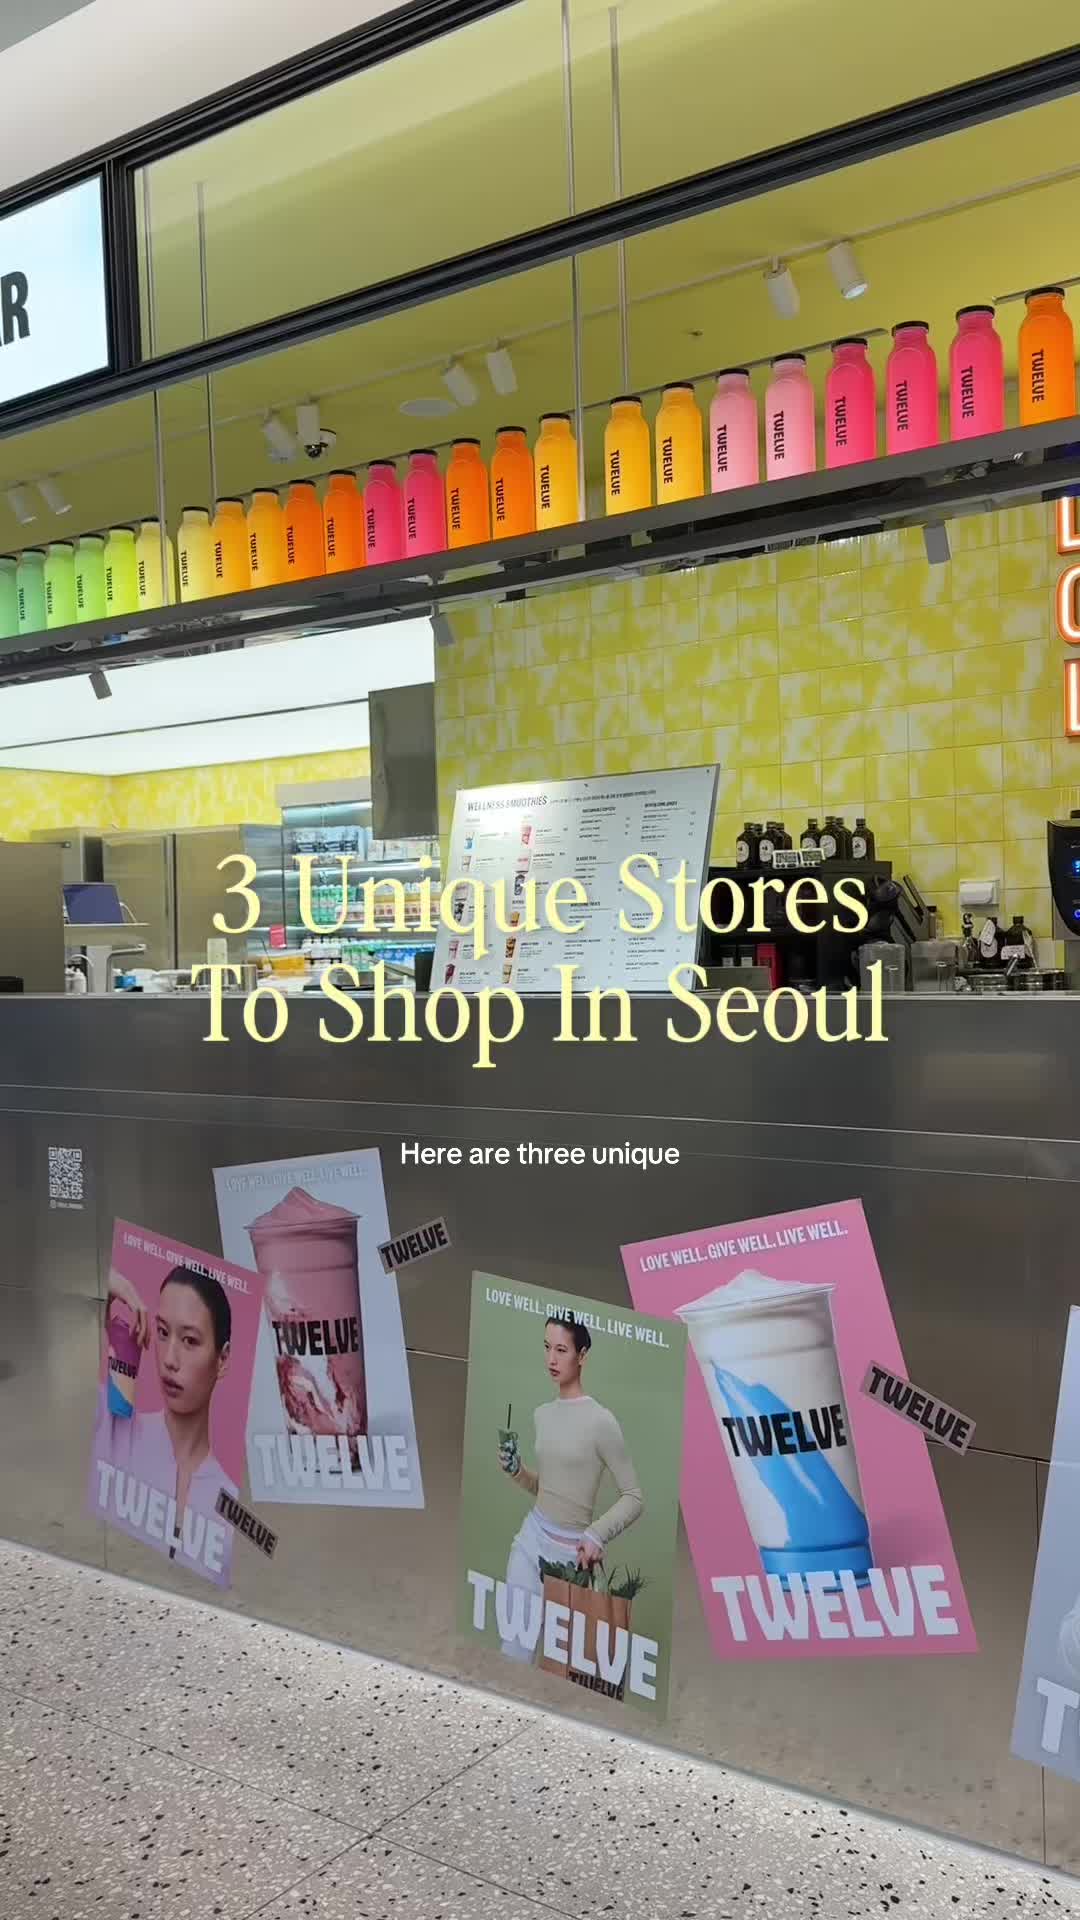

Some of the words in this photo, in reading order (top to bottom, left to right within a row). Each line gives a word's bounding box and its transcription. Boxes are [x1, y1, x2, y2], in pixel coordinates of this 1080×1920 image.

[0, 271, 30, 347] R
[961, 366, 974, 419] TWELVE
[1032, 349, 1044, 403] TWELVE
[835, 396, 847, 447] TWELVE
[896, 380, 908, 432] TWELVE
[662, 436, 673, 484] TWELVE
[717, 424, 728, 473] TWELVE
[773, 410, 785, 460] TWELVE
[540, 464, 551, 509] TWELVE
[610, 450, 621, 496] TWELVE
[406, 497, 417, 540] TWELVE
[450, 487, 461, 529] TWELVE
[496, 477, 505, 521] TWELVE
[250, 532, 258, 571] TWELVE
[286, 525, 295, 565] TWELVE
[327, 517, 336, 558] TWELVE
[366, 508, 376, 549] TWELVE
[180, 550, 188, 587] TWELVE
[214, 541, 223, 578] TWELVE
[124, 1231, 142, 1249] LOVE
[166, 1249, 184, 1267] GIVE
[208, 1266, 227, 1285] LIVE
[381, 1222, 448, 1269] TWELVE
[640, 1252, 670, 1272] LOVE
[671, 1246, 708, 1266] WELL.
[708, 1239, 737, 1260] GIVE
[737, 1233, 776, 1254] WELL.
[776, 1227, 806, 1247] LIVE
[808, 1220, 849, 1241] WELL.
[272, 1316, 360, 1356] TWELVE
[485, 1287, 513, 1307] LOVE
[513, 1294, 545, 1316] WELL.
[546, 1303, 571, 1323] GIVE
[572, 1309, 606, 1332] WELL.
[607, 1318, 633, 1339] LIVE
[634, 1326, 670, 1349] WELL.
[722, 1403, 848, 1458] TWELVE
[870, 1366, 971, 1449] TWELVE
[254, 1434, 411, 1492] TWELVE
[97, 1459, 227, 1574] TWELVE
[219, 1491, 276, 1555] TWELVE
[711, 1564, 960, 1642] TWELVE
[467, 1568, 659, 1701] TWELVE
[1037, 1676, 1080, 1754] T
